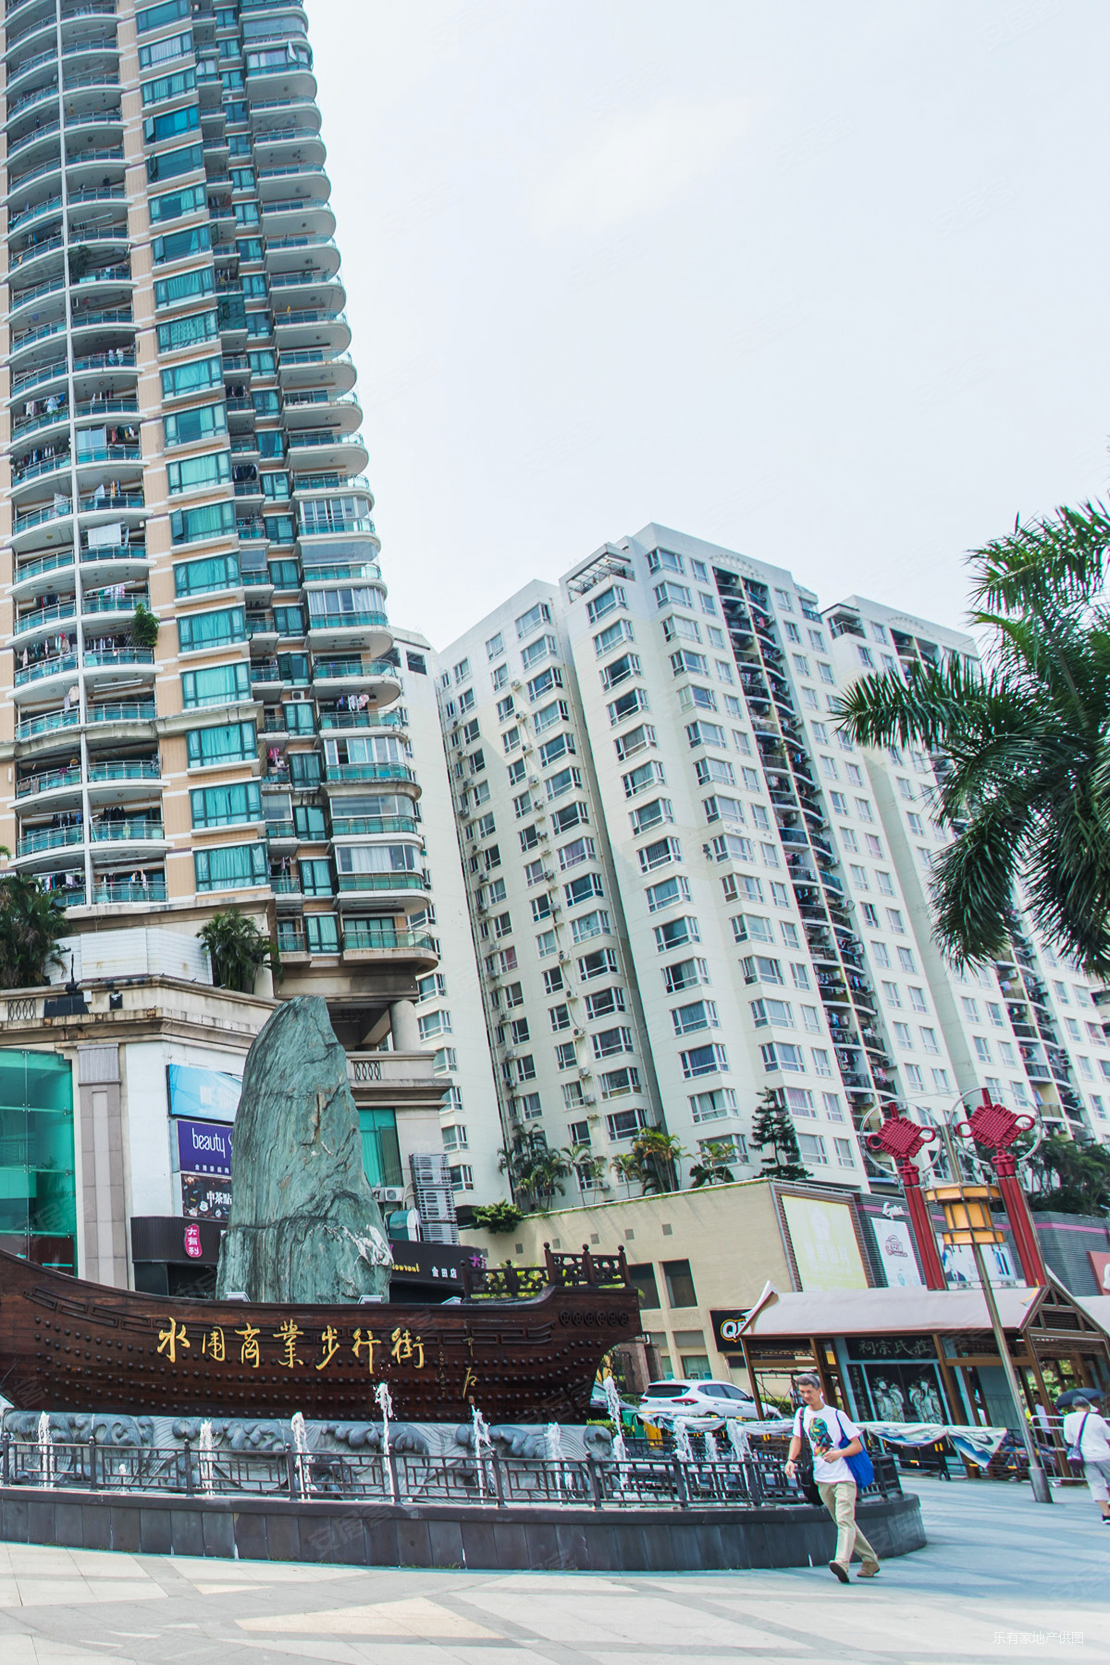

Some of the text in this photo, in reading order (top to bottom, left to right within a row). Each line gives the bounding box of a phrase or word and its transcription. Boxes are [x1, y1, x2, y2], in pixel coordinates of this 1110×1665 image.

[192, 1127, 226, 1159] beauty
[431, 1265, 457, 1279] 金田店
